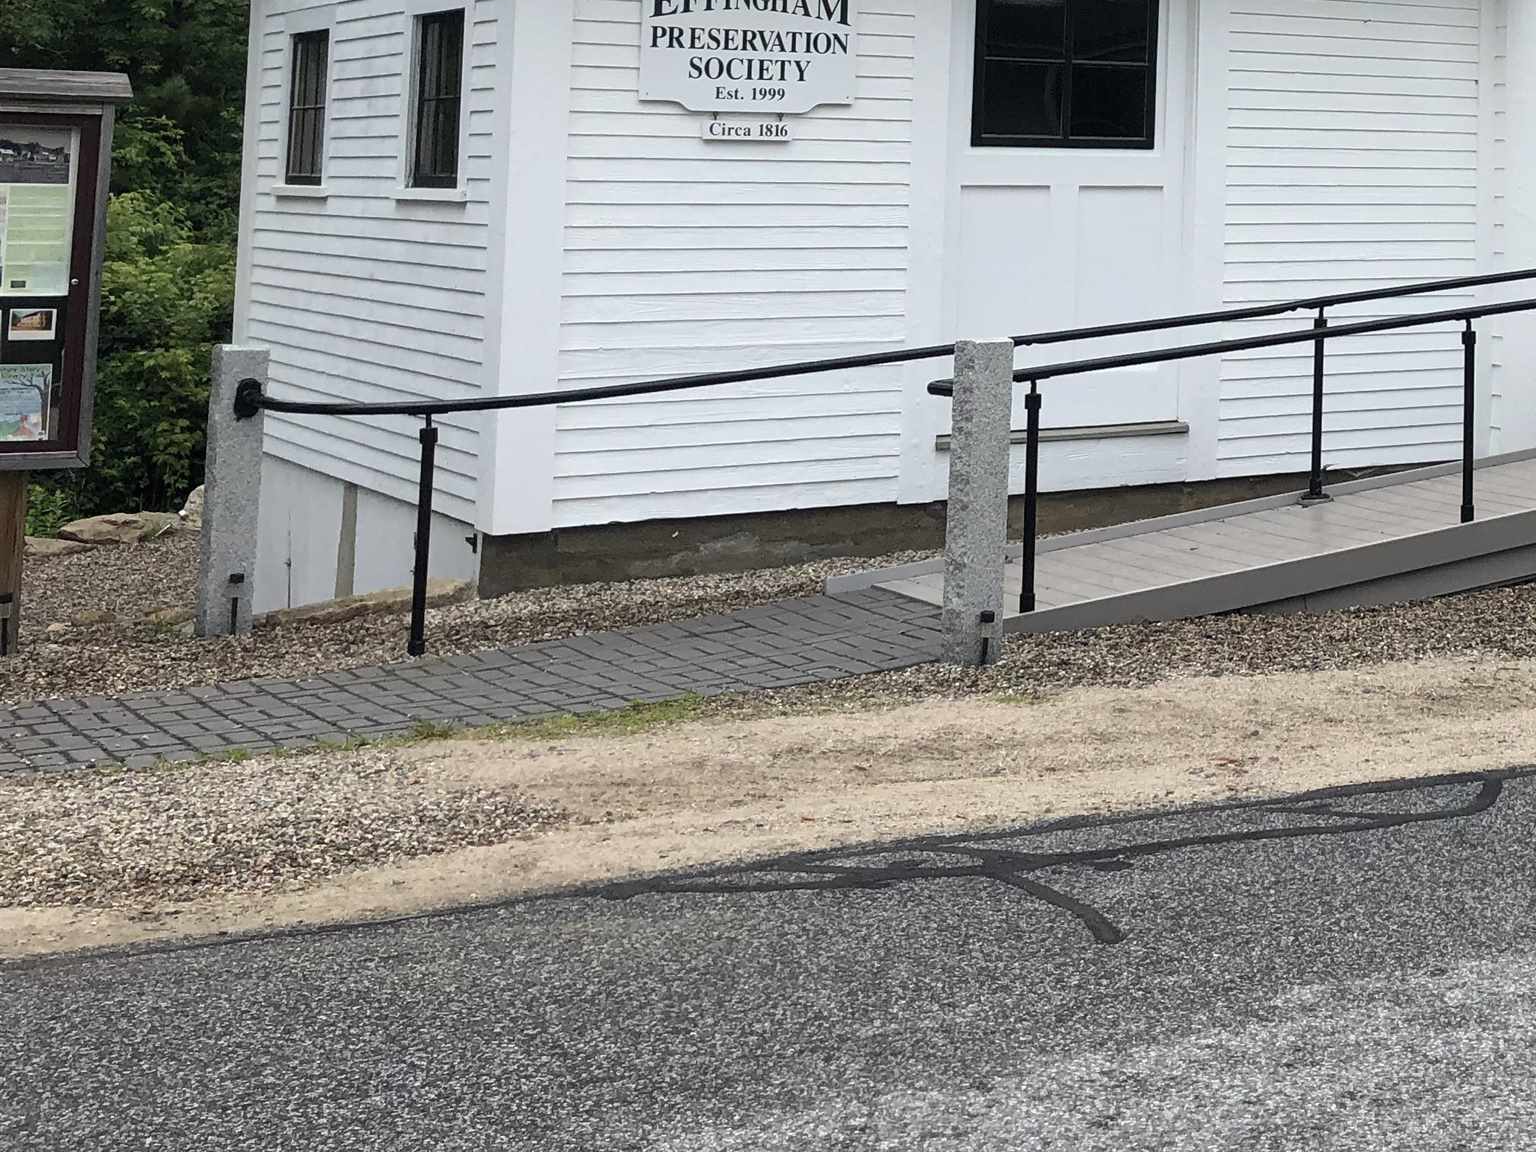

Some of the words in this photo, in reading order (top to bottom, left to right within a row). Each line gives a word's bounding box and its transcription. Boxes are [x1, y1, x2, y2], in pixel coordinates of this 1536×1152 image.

[649, 25, 848, 55] PRESERVATION
[688, 56, 811, 82] SOCIETY
[715, 86, 744, 101] Est.
[751, 87, 786, 101] 1999
[709, 122, 751, 137] Circa
[759, 123, 788, 137] 1816
